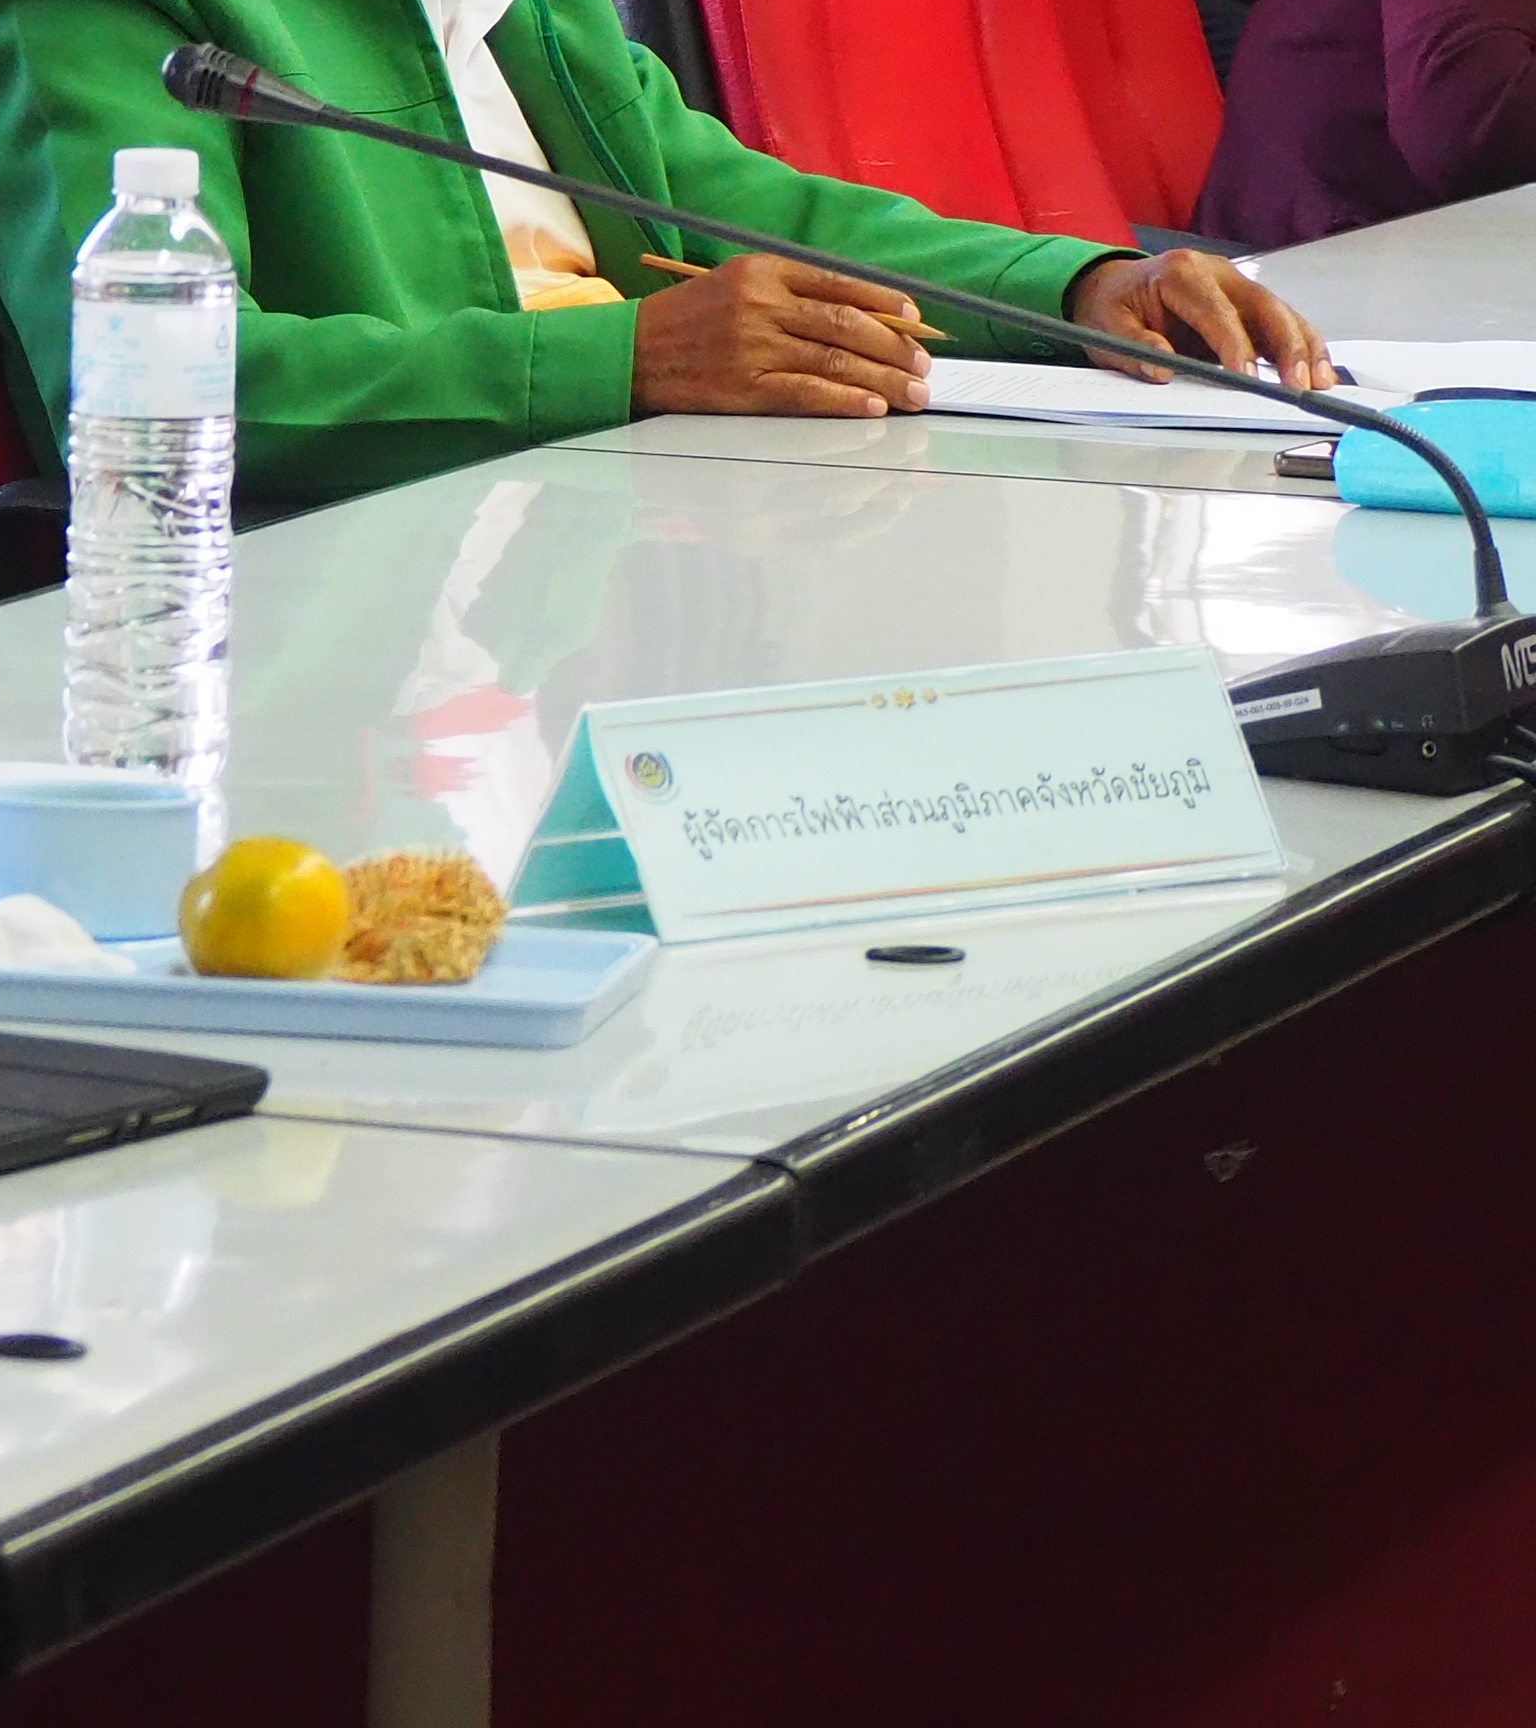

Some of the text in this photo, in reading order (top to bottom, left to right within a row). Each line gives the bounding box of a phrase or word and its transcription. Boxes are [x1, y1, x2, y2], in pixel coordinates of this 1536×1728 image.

[682, 757, 1212, 861] ผู้จัดการไฟฟ้าส่วนภูมิภาคจังหวัดชัยภูมิ
